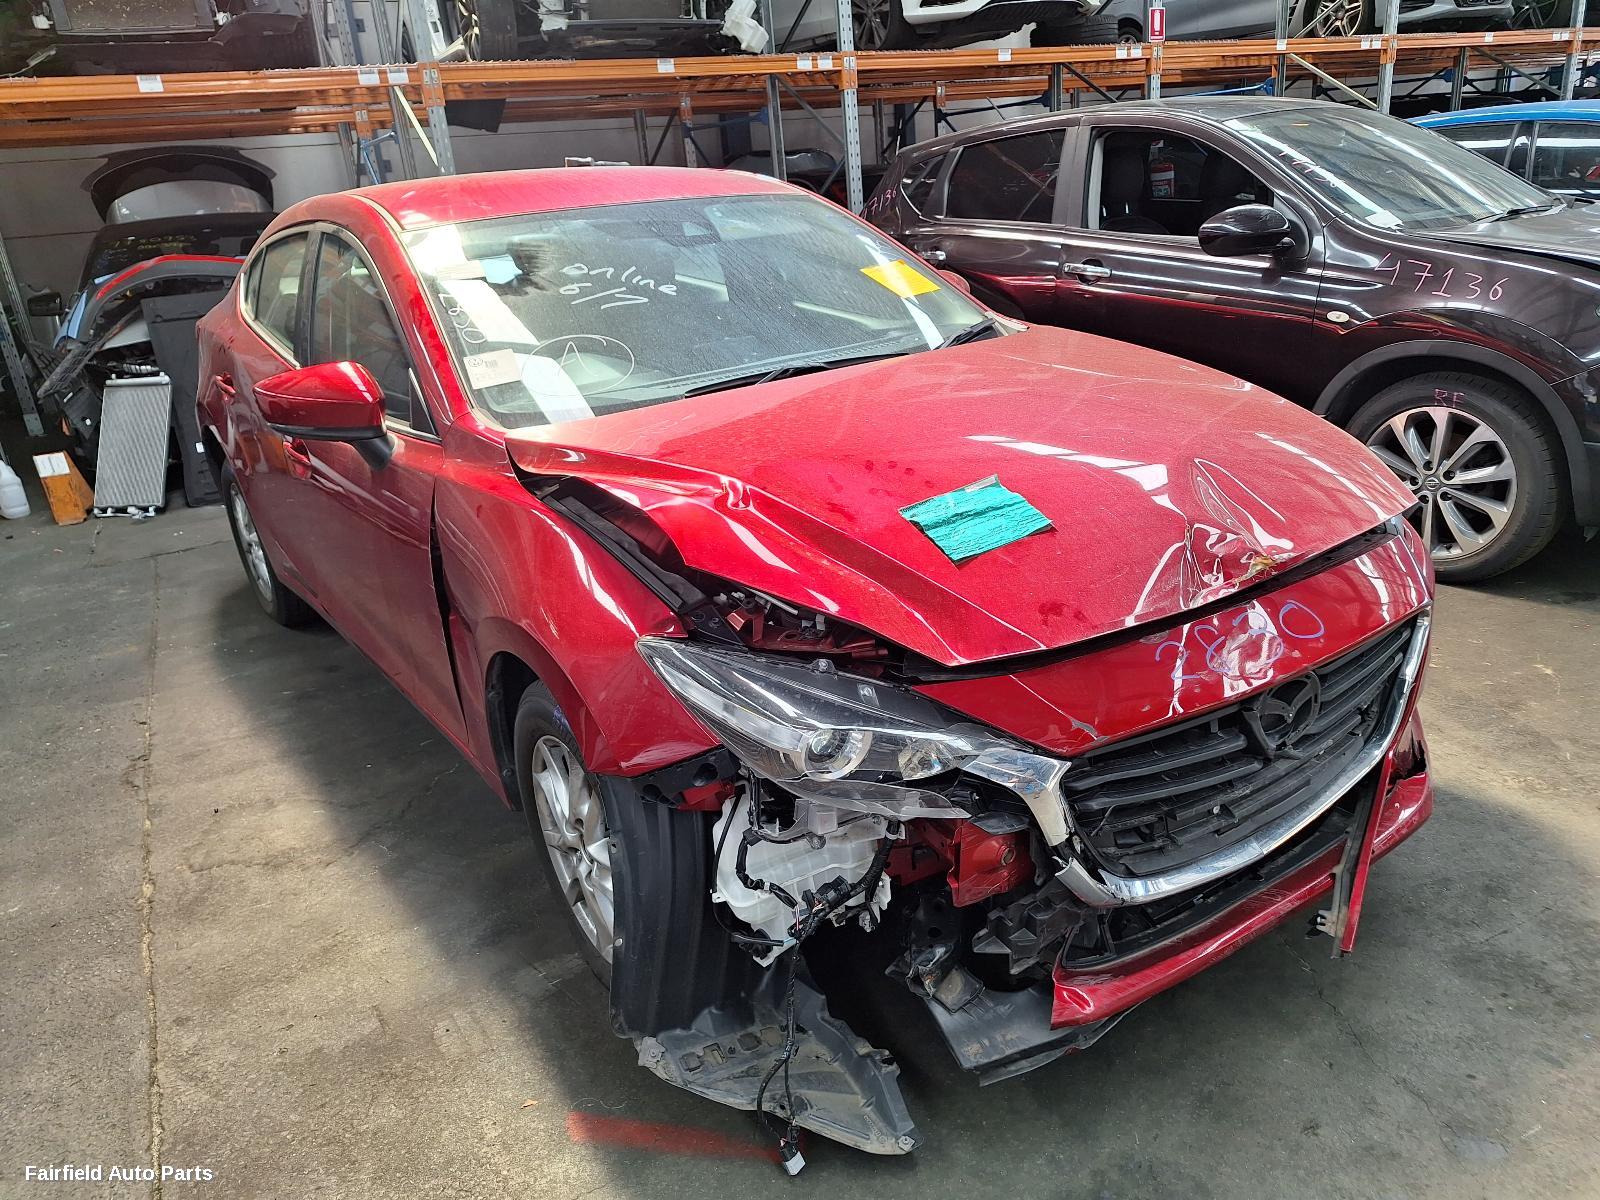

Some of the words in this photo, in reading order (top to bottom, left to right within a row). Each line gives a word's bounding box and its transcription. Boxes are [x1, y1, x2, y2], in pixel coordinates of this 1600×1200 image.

[1374, 252, 1510, 301] 47136
[557, 340, 599, 377] A
[1433, 388, 1465, 408] RF
[1154, 599, 1325, 680] 2830
